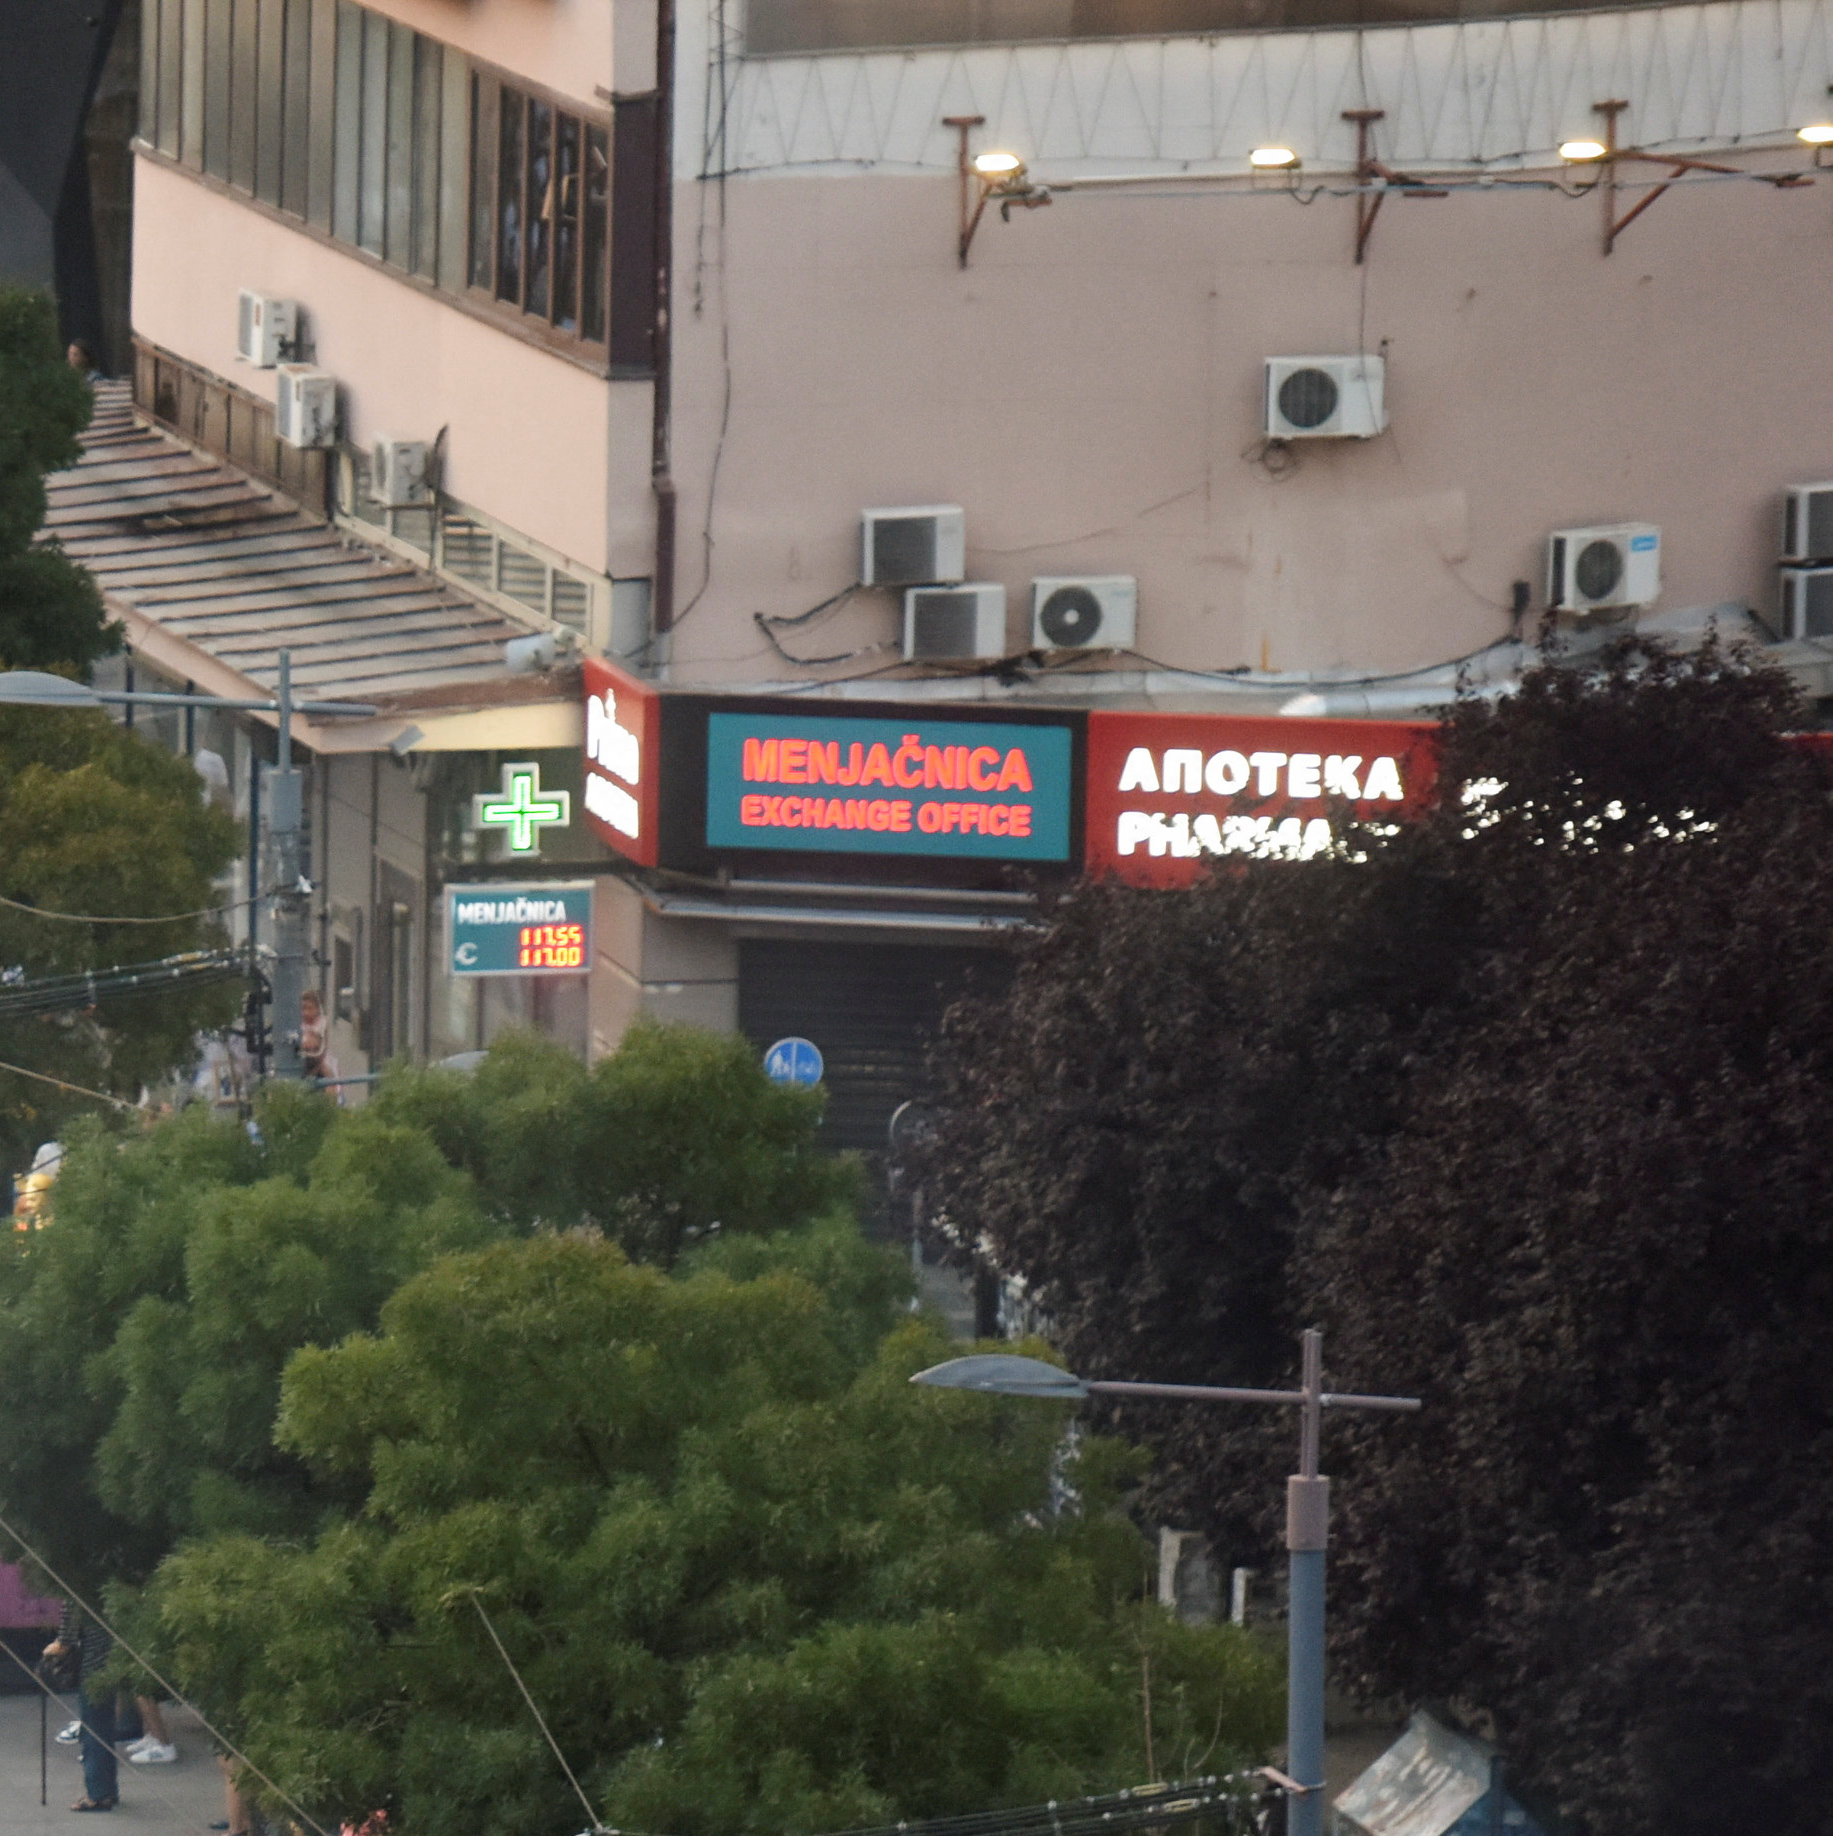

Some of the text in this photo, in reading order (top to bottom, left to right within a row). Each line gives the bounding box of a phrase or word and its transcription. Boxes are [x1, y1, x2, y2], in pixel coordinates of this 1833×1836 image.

[743, 734, 1033, 792] MENJAČNICA
[1118, 747, 1404, 801] АПОТЕКА
[741, 794, 1033, 838] EXCHANGE OFFICE
[457, 896, 567, 924] MENJAČNICA
